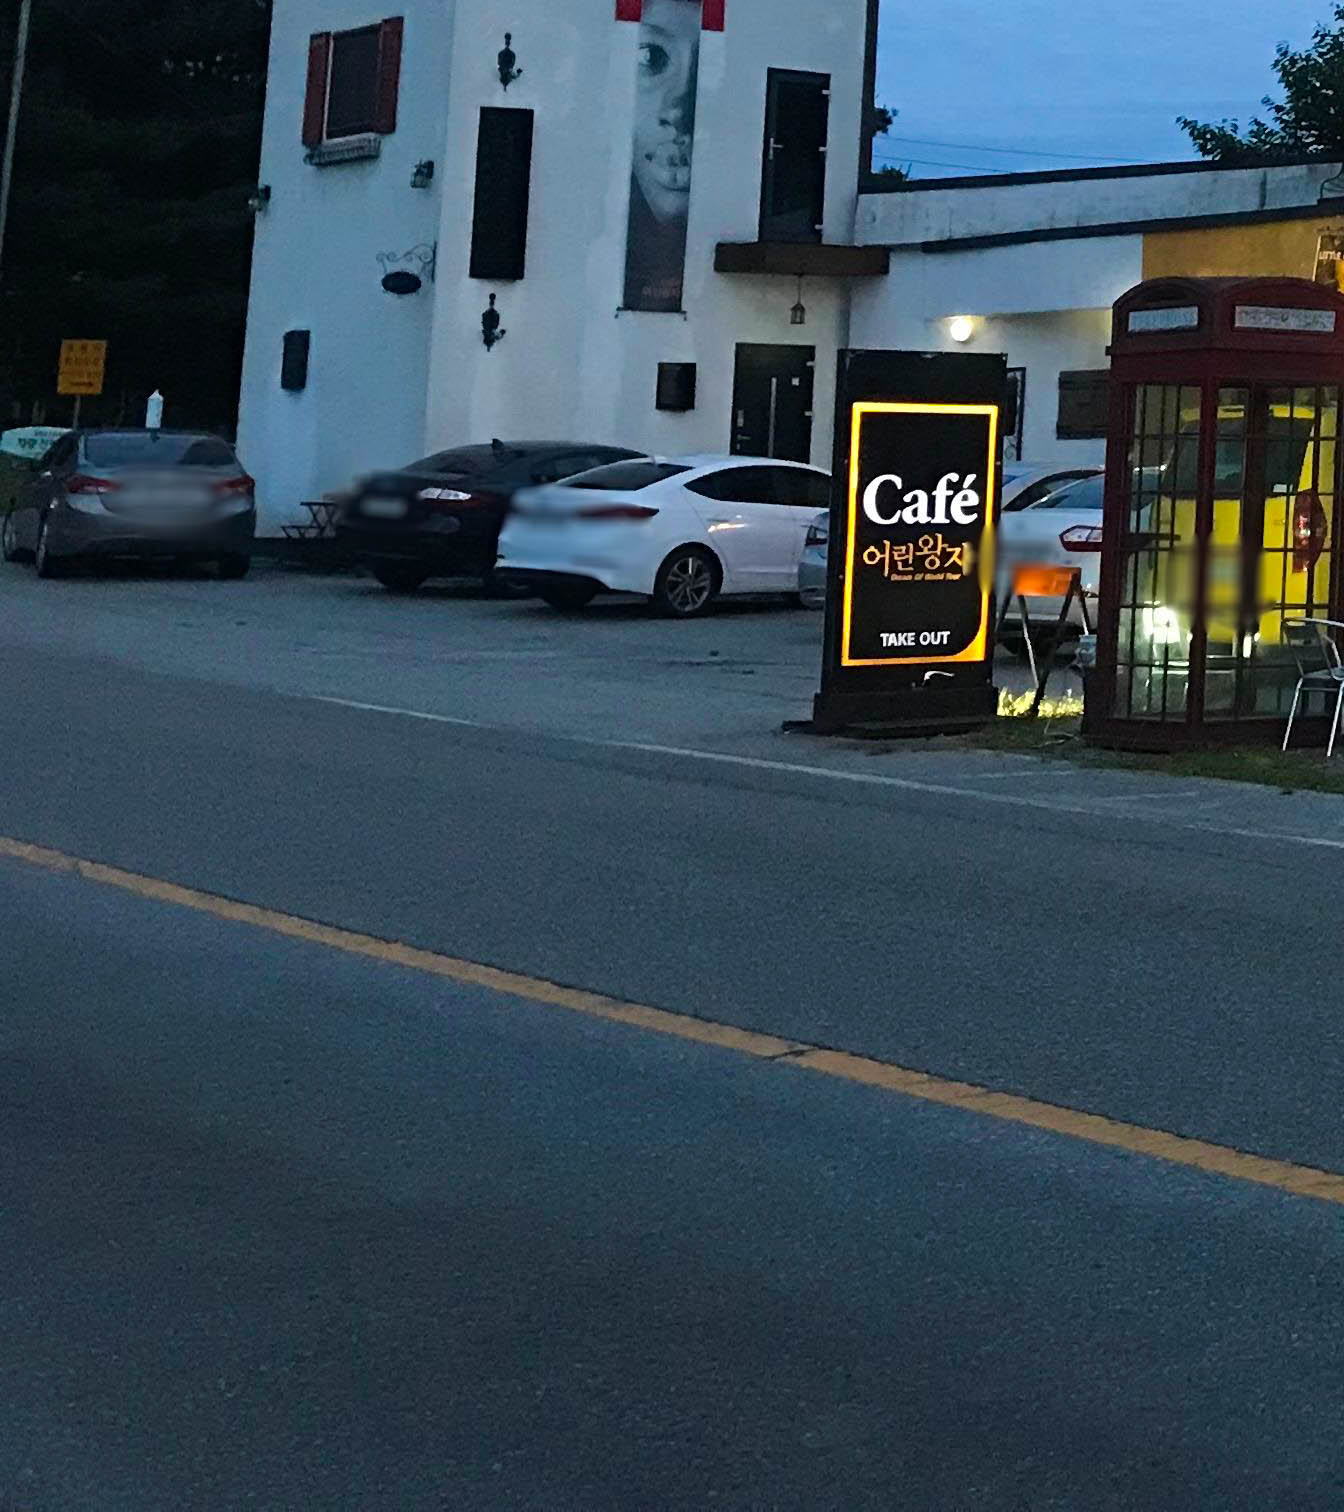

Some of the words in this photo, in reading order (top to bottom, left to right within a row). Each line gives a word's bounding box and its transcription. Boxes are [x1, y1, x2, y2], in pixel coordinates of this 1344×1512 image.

[1319, 250, 1342, 260] LITTLE
[862, 472, 980, 525] Café
[880, 632, 916, 648] TAKE
[919, 630, 951, 646] OUT
